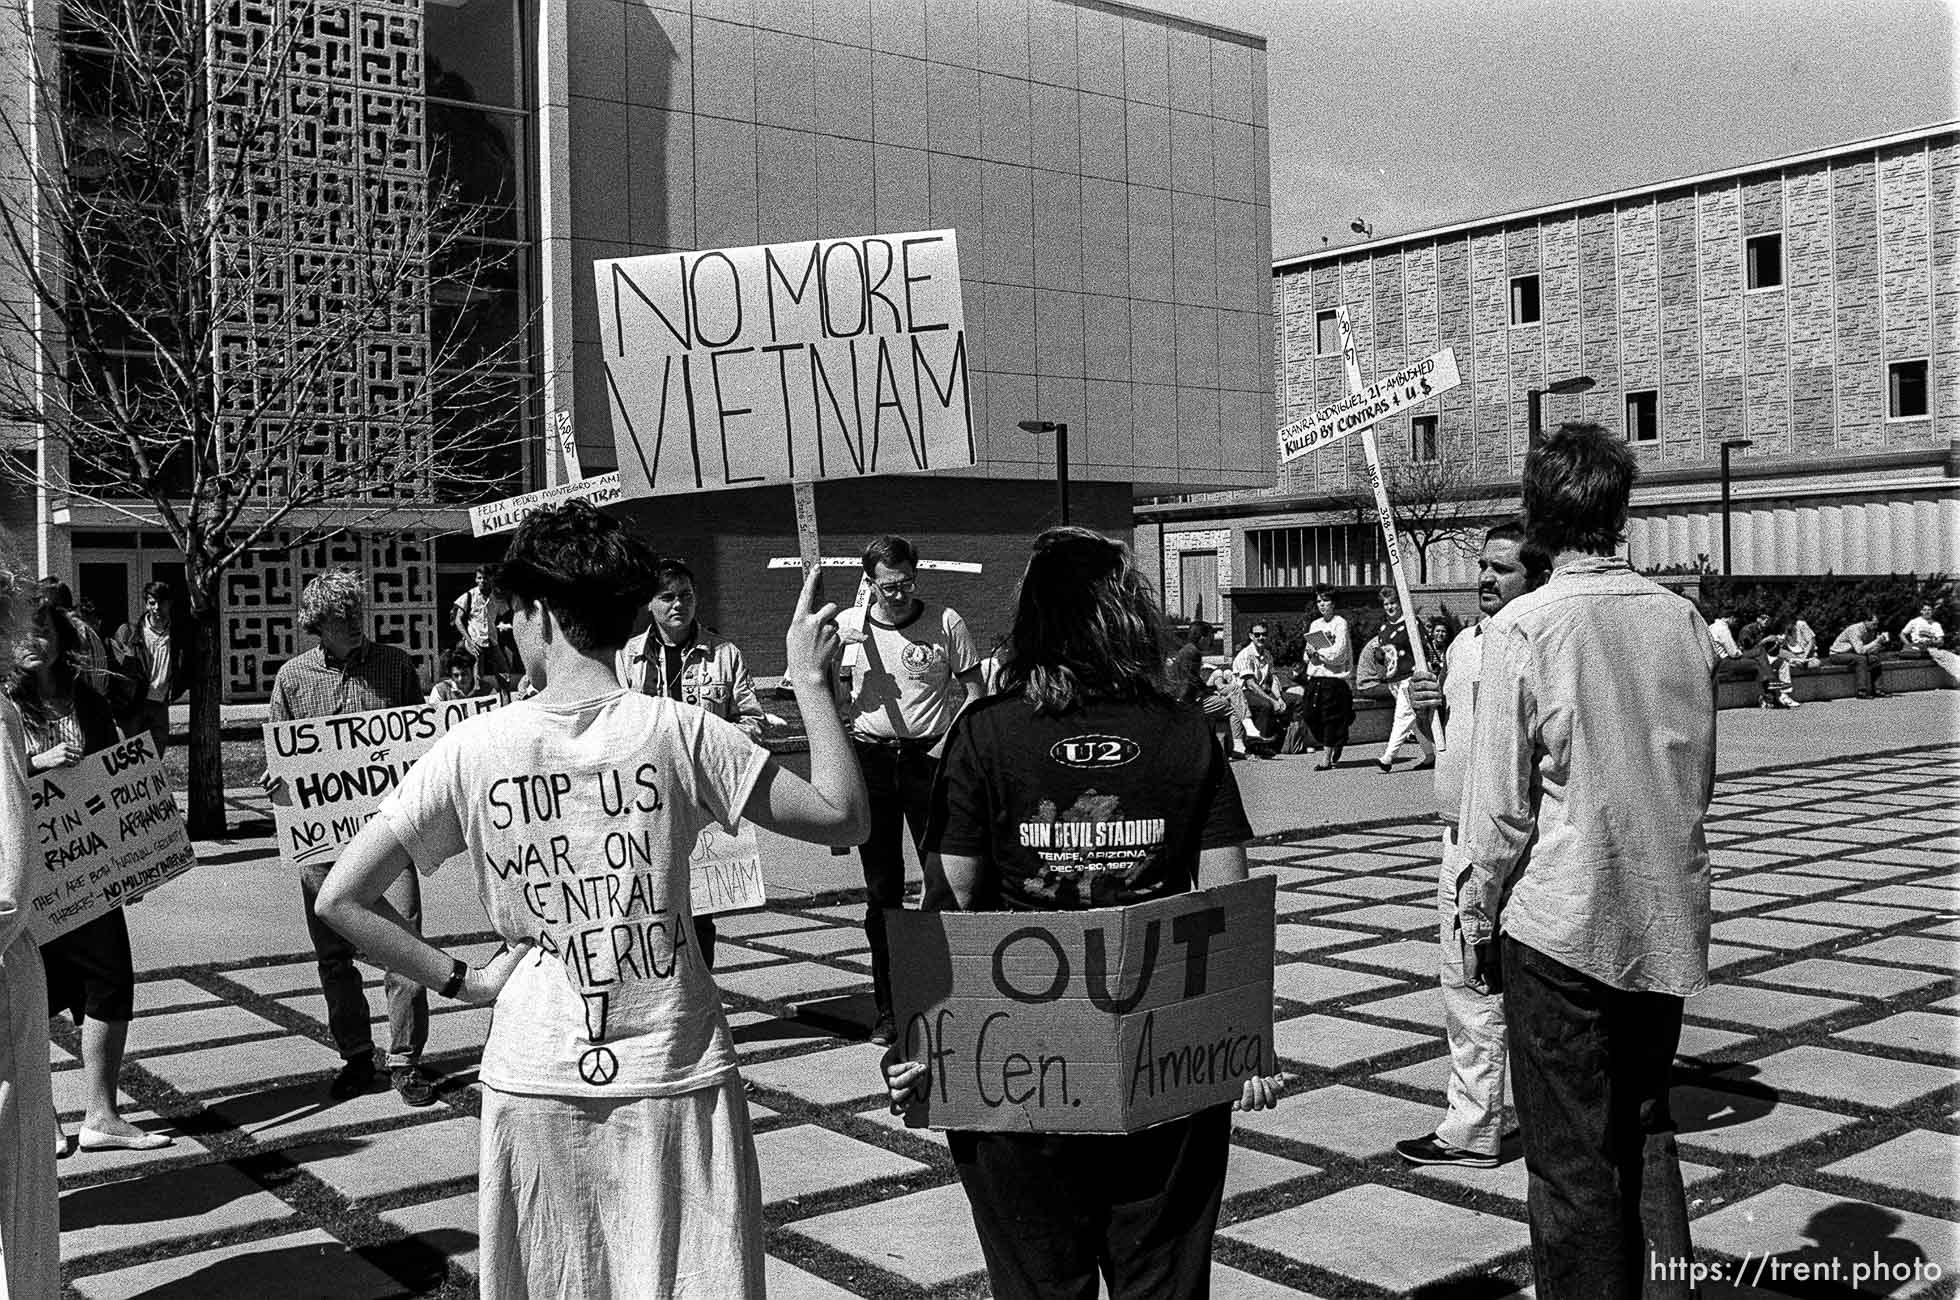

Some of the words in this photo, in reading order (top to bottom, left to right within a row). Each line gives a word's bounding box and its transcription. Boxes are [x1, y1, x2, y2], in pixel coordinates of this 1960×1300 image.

[612, 251, 742, 357] NO
[765, 237, 949, 341] MORE
[604, 330, 975, 488] VIETNAM
[1285, 430, 1318, 456] KILLED
[1320, 422, 1333, 439] BY
[1337, 399, 1390, 432] CONTRAS
[478, 501, 505, 517] FELIX
[512, 494, 538, 507] PEDRO
[482, 508, 532, 533] KILLED
[325, 707, 437, 750] TROOPS
[1063, 741, 1122, 762] U2
[101, 737, 154, 777] USSR
[370, 749, 391, 763] OF
[61, 809, 82, 834] IN
[110, 777, 151, 810] POLICY
[152, 769, 168, 796] IN
[489, 773, 571, 829] STOP
[598, 763, 663, 817] U.S.
[290, 820, 326, 851] NO
[486, 835, 575, 880] WAR
[605, 830, 653, 870] ON
[1019, 822, 1050, 847] SUN
[1055, 821, 1093, 848] DEVIL
[1095, 818, 1165, 847] STADIUM
[1038, 851, 1083, 863] TEMPE,
[1086, 849, 1147, 859] ARIZONA
[32, 888, 61, 912] THEY
[65, 873, 87, 895] ARE
[89, 863, 112, 885] BOTH
[103, 880, 123, 901] NO
[524, 873, 667, 924] CENTRAL
[992, 906, 1226, 1015] OUT
[976, 1011, 1081, 1108] Cen.
[1129, 1010, 1262, 1106] America
